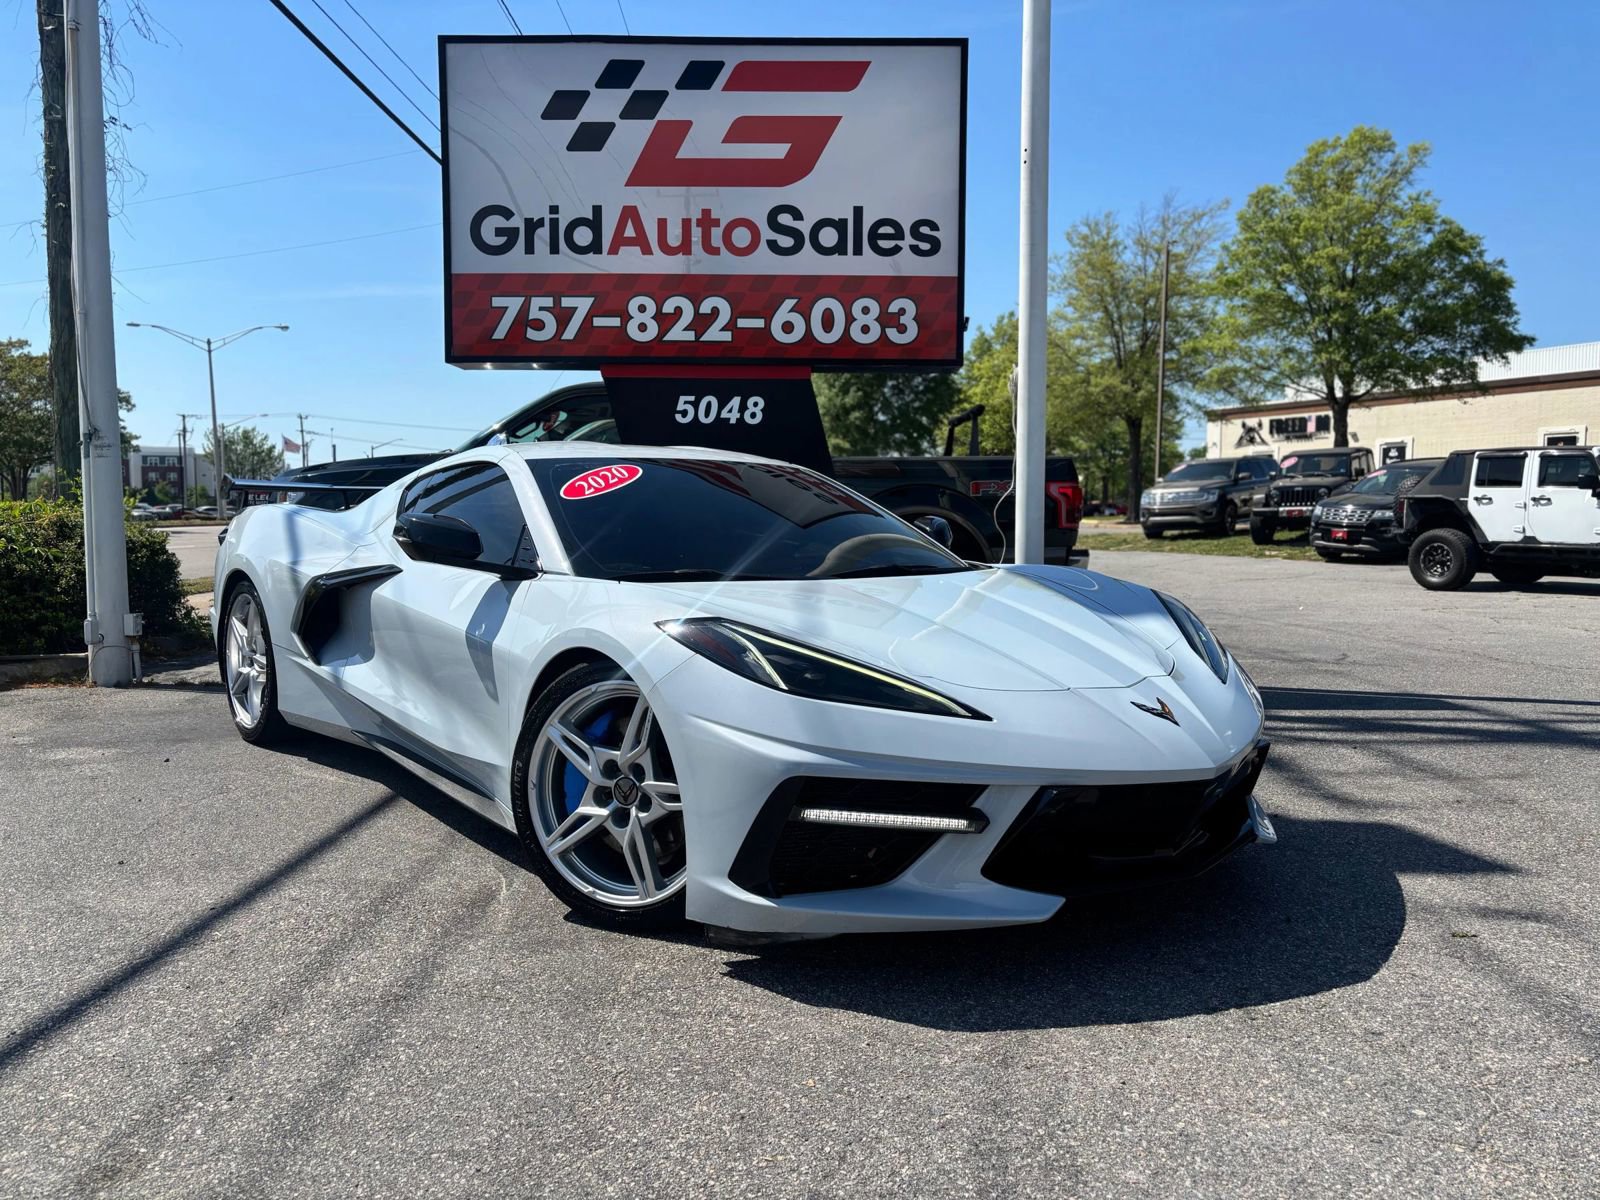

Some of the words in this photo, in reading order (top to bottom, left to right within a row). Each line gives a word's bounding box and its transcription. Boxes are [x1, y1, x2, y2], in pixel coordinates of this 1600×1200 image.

[490, 296, 920, 345] 757-822-6083
[674, 395, 765, 425] 5048
[575, 466, 629, 495] 2020
[970, 480, 1016, 496] FX
